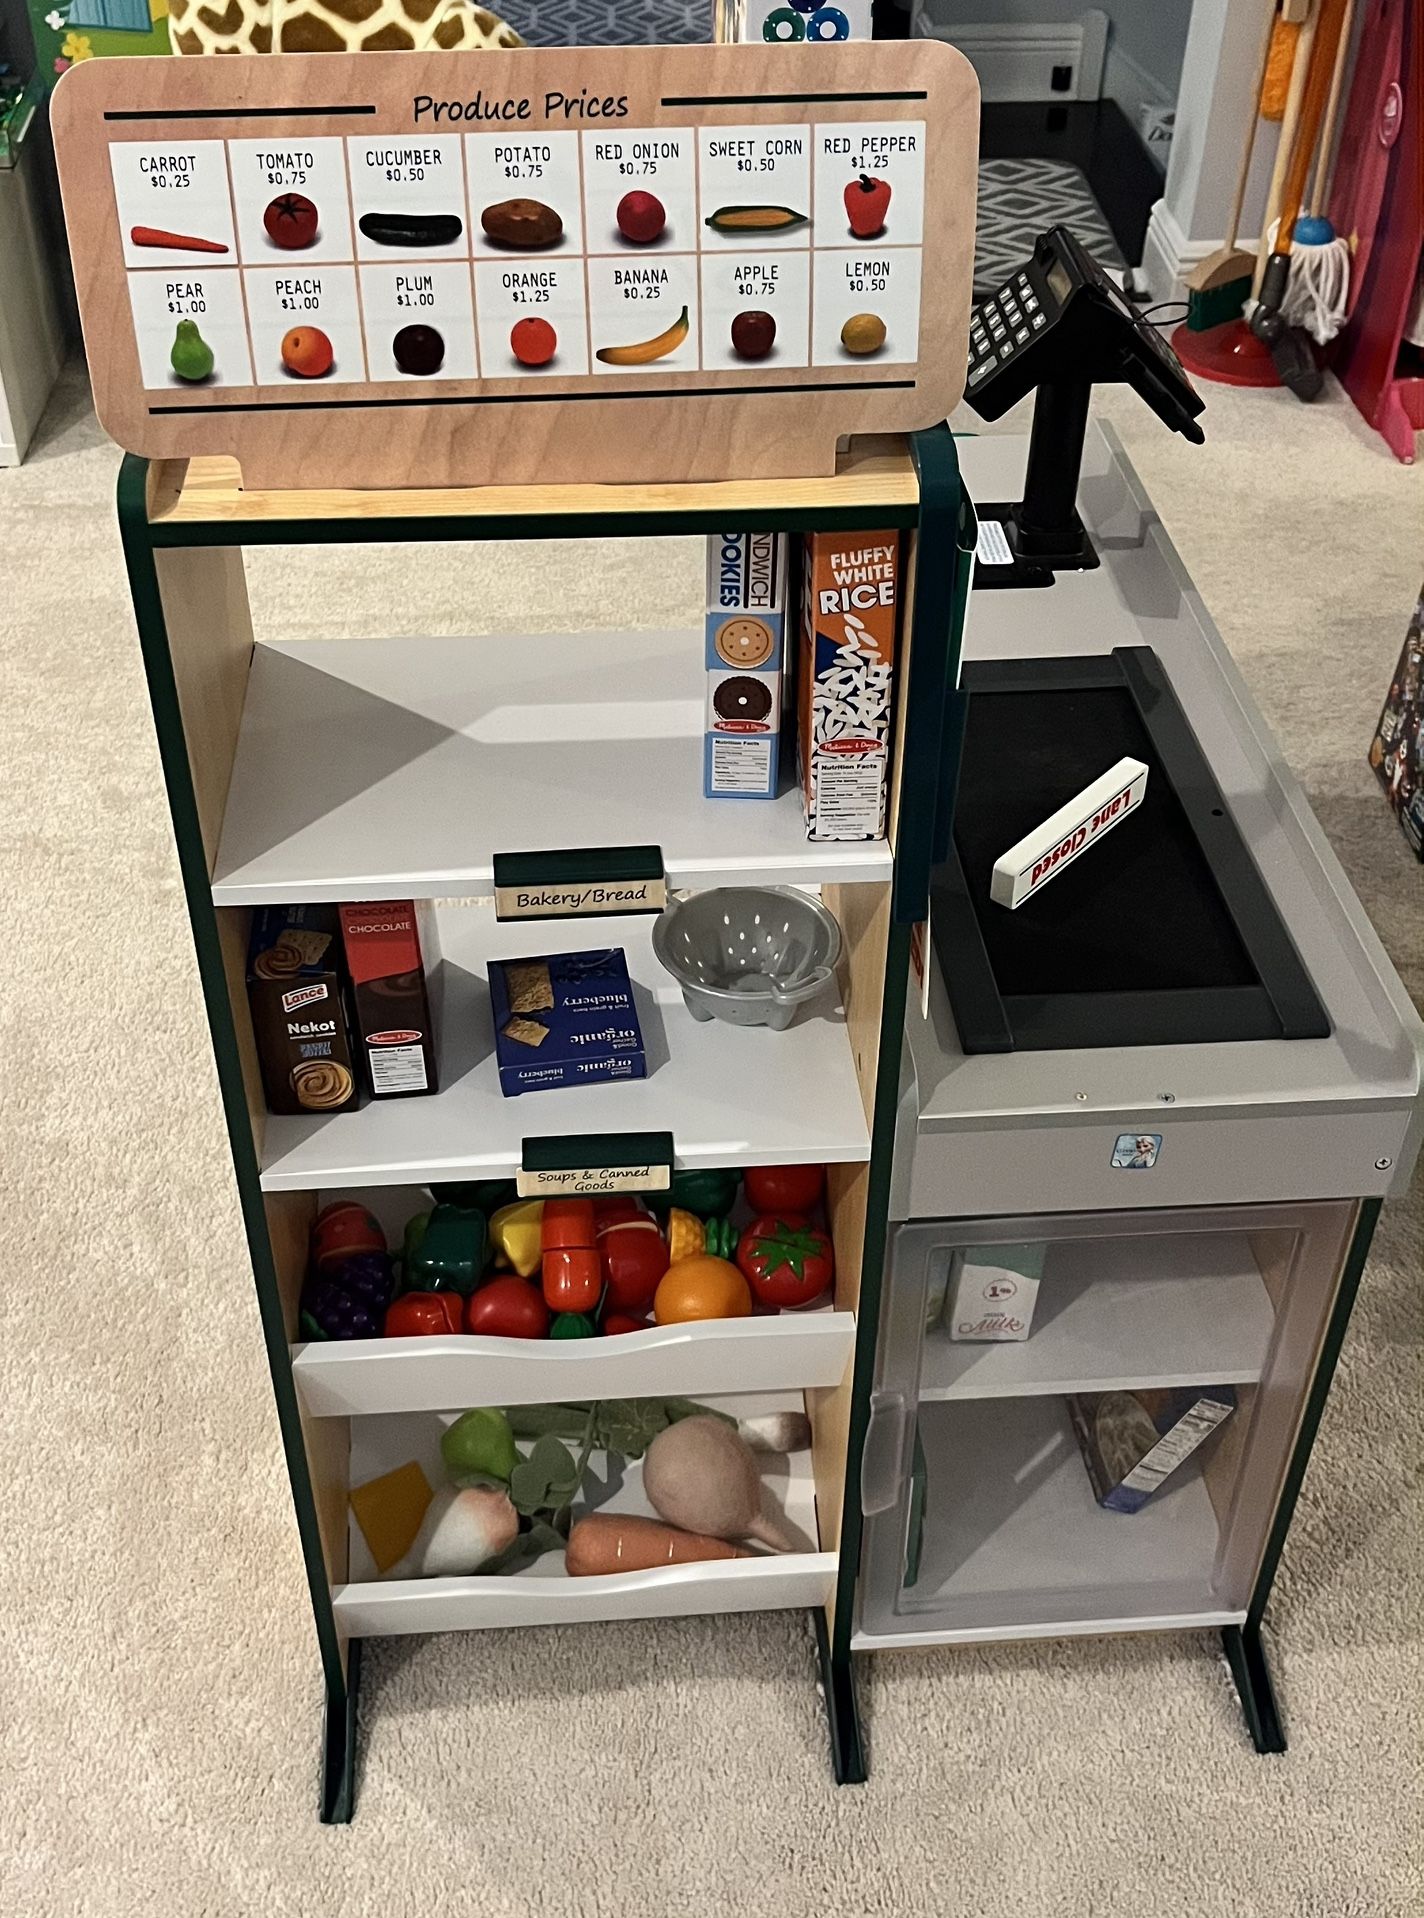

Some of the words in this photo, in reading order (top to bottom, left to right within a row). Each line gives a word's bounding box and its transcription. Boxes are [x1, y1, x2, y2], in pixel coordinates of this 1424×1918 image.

[413, 90, 532, 123] Produce
[545, 88, 629, 120] Prices
[595, 144, 623, 161] RED
[632, 142, 679, 160] ONION
[709, 140, 756, 157] SWEET
[765, 139, 802, 156] CORN
[824, 137, 851, 154] RED
[861, 136, 916, 153] PEPPER
[255, 152, 314, 170] TOMATO
[366, 149, 442, 167] CUCUMBER
[494, 146, 551, 163] POTATO
[851, 154, 889, 169] $1.25
[139, 155, 196, 173] CARROT
[504, 164, 543, 179] $0.75
[619, 161, 657, 175] $0.75
[737, 158, 775, 172] $0.50
[151, 174, 190, 188] $0.25
[267, 171, 306, 185] $0.75
[386, 167, 425, 182] $0.50
[614, 268, 669, 285] BANANA
[734, 264, 779, 281] APPLE
[845, 261, 890, 278] LEMON
[275, 279, 322, 295] PEACH
[396, 275, 433, 292] PLUM
[502, 272, 558, 289] ORANGE
[738, 282, 775, 296] $0.75
[849, 278, 886, 292] $0.50
[166, 282, 204, 299] PEAR
[512, 289, 550, 303] $1.25
[623, 286, 661, 300] $0.25
[168, 300, 206, 314] $1.00
[281, 296, 319, 310] $1.00
[396, 293, 435, 307] $1.00
[830, 545, 895, 569] FLUFFY
[833, 563, 894, 586] WHITE
[819, 580, 895, 615] RICE
[1091, 788, 1132, 833] Lane
[1029, 827, 1087, 887] Closed
[517, 884, 648, 909] Bakery/Bread
[348, 921, 412, 934] CHOCOLATE
[283, 986, 325, 1007] Lance
[561, 993, 629, 1007] blueberry
[286, 1019, 337, 1035] Nekot
[569, 1027, 636, 1045] organic
[517, 1067, 564, 1079] blueberry
[575, 1058, 632, 1073] organic
[537, 1170, 578, 1184] Soups
[581, 1170, 594, 1181] &
[598, 1166, 650, 1179] Canned
[574, 1179, 616, 1192] Goods
